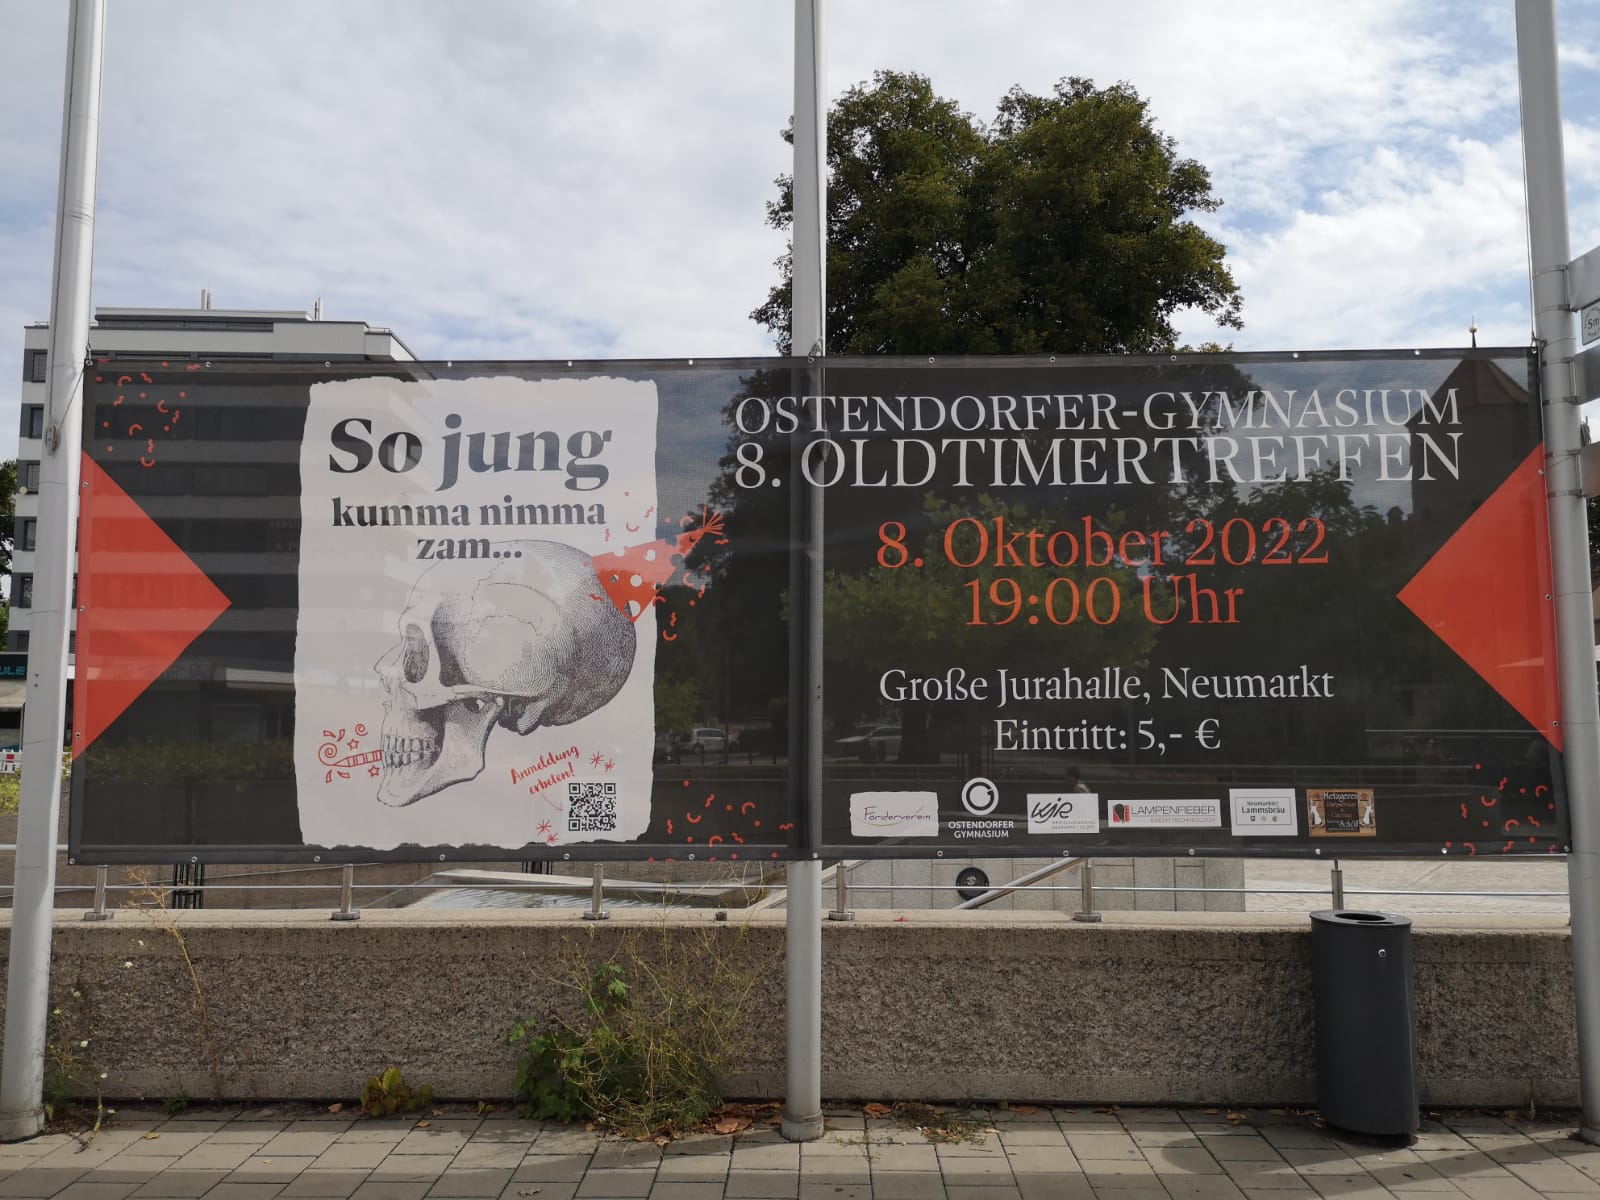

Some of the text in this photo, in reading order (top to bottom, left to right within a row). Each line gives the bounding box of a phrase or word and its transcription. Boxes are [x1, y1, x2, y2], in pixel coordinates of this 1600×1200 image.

[735, 388, 1463, 434] OSTENDORFER-GYMNASIUM
[329, 413, 613, 492] So jung
[735, 432, 1464, 489] 8. OLDTIMERTREFFEN
[331, 494, 607, 527] kumma nimma
[416, 536, 523, 560] zam...
[877, 515, 1330, 568] 8. Oktober 2022
[963, 572, 1244, 626] 19:00 Uhr
[879, 665, 1335, 708] Große Jurahalle, Neumarkt
[993, 718, 1221, 756] Eintritt: 5,- €
[510, 745, 580, 784] Anmeldung
[529, 761, 575, 795] erbeten!
[948, 820, 1015, 829] OSTENDORFER
[1130, 805, 1216, 815] LAMPENFIEBER
[953, 830, 1009, 839] GYMNASIUM
